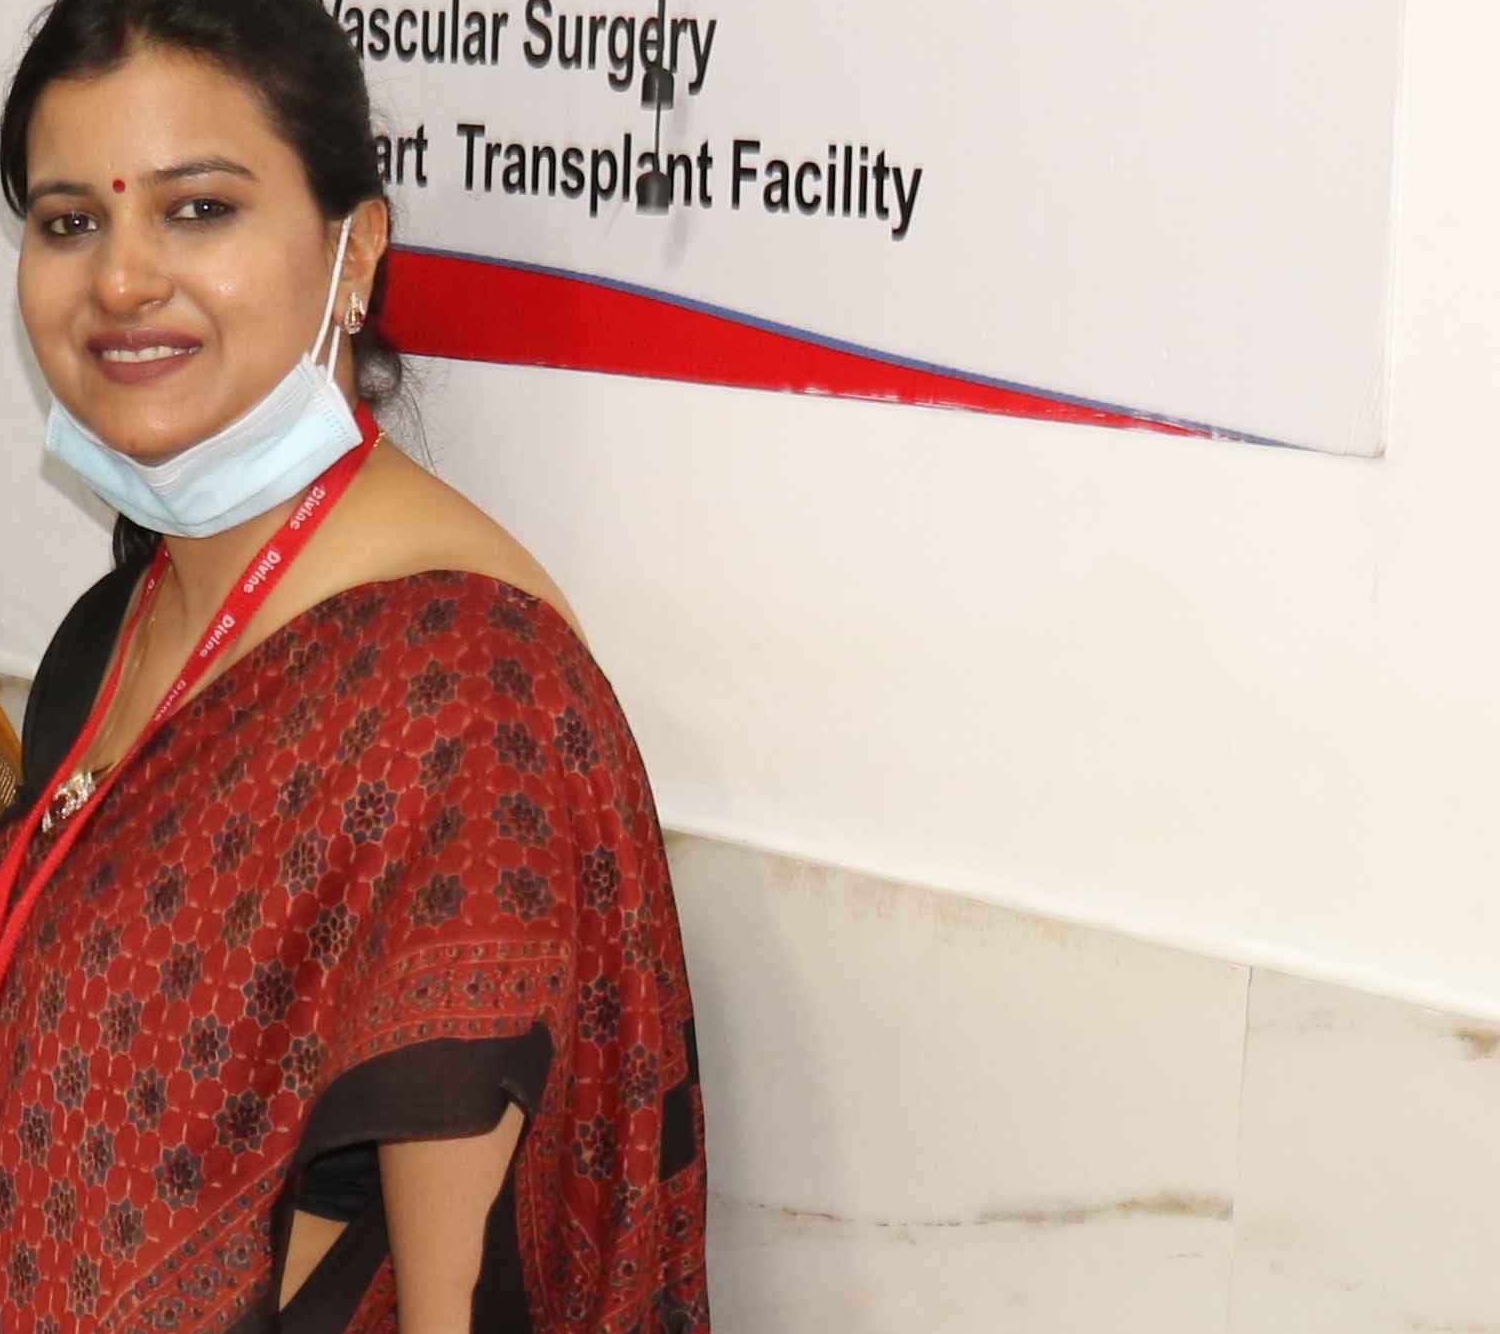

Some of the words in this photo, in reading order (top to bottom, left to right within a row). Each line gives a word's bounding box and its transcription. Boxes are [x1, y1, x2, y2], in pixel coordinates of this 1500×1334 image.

[374, 124, 428, 186] art
[731, 139, 923, 240] Facility
[290, 485, 326, 531] Divine
[243, 549, 282, 594] Divine
[199, 613, 237, 658] Divine
